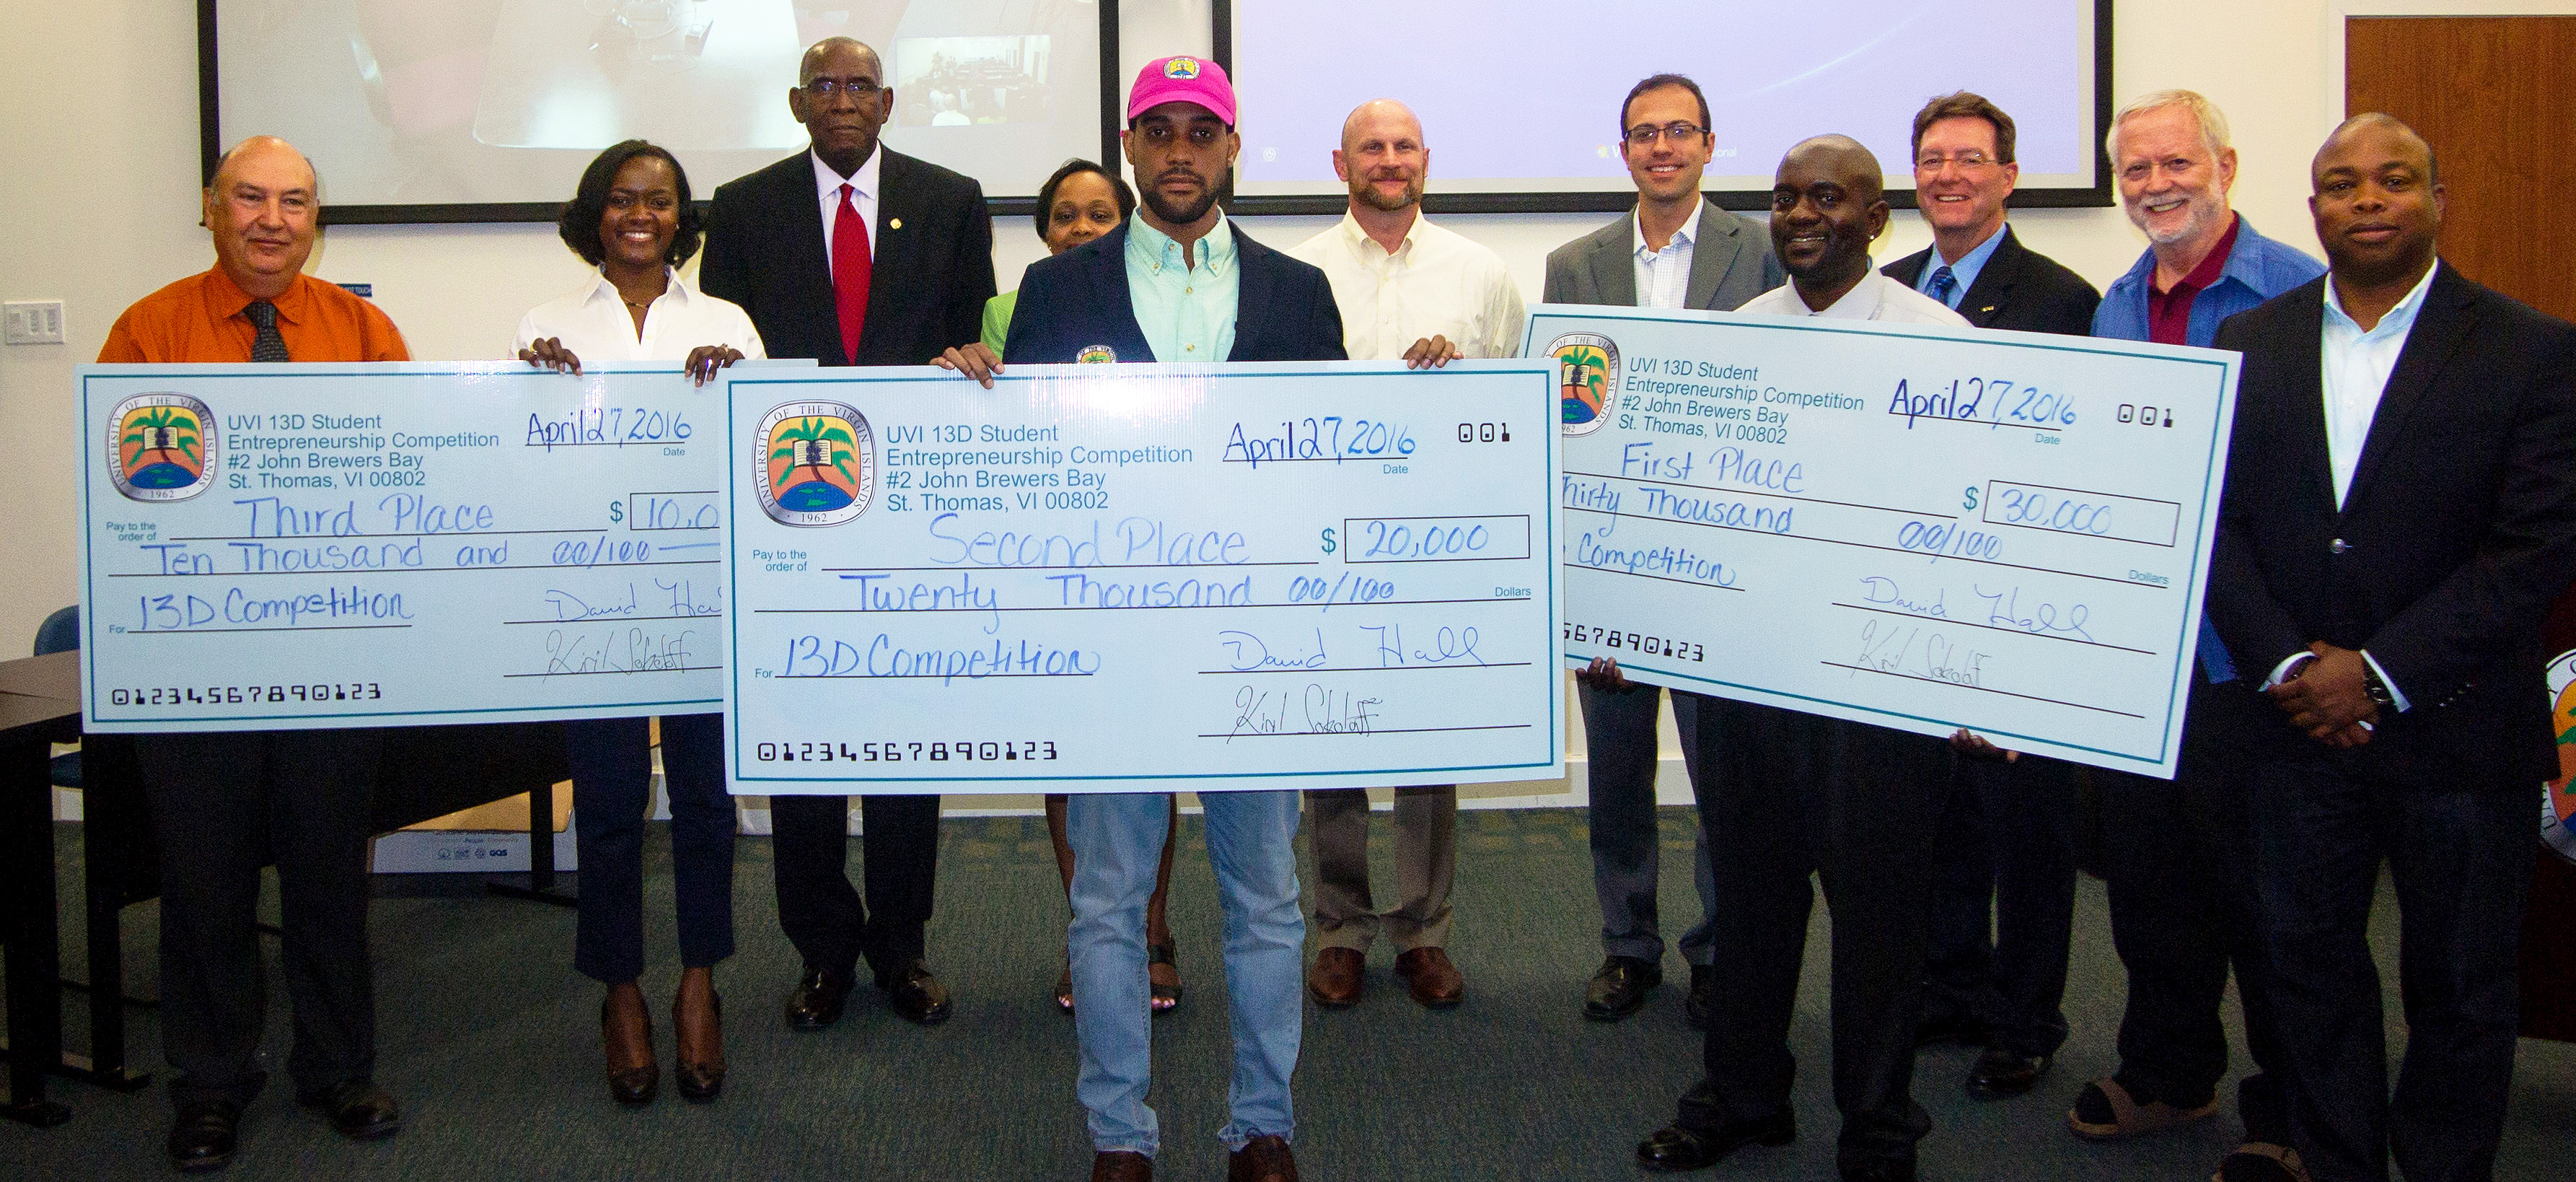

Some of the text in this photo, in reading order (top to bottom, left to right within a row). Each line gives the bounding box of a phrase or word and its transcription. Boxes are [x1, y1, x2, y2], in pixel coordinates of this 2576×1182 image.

[1556, 338, 1568, 347] OF
[1597, 338, 1618, 370] VIRGIN
[1629, 357, 1759, 382] UVI 13D Student
[1595, 377, 1616, 425] ISLANDS
[1625, 376, 1865, 412] Entrepreneurship Competition
[228, 413, 382, 431] UVI 13D Student
[1622, 397, 1790, 426] #2 John Brewers Bay
[2117, 403, 2173, 428] 001
[887, 424, 1059, 442] UVI 13D Student
[1459, 422, 1511, 443] 001
[1619, 414, 1788, 445] St. Thomas, VI 00802
[2035, 434, 2062, 446] Date
[110, 416, 127, 486] UNIVERSITY
[126, 399, 139, 411] OF
[180, 398, 212, 429] VIRGIN
[198, 437, 214, 487] ISLANDS
[228, 432, 500, 451] Entrepreneurship Competition
[663, 447, 685, 456] Date
[228, 452, 424, 471] #2 John Brewers Bay
[757, 406, 871, 509] UNIVERSITY OF THE VIRGIN ISLANDS
[887, 445, 1192, 468] Entrepreneurship Competition
[1621, 442, 1805, 494] First Place
[228, 471, 426, 489] St. Thomas, VI 00802
[887, 469, 1106, 491] #2 John Brewers Bay
[1383, 465, 1408, 474] Date
[151, 490, 175, 499] 1962
[887, 491, 1109, 514] St. Thomas, VI 00802
[234, 492, 494, 538] Third Place
[610, 497, 718, 532] $ 10,0
[801, 513, 827, 522] 1962
[1563, 476, 2003, 564] hirty Thousand 00/100
[1963, 486, 2113, 535] $ 30,000
[106, 521, 157, 533] Pay to the
[118, 532, 157, 541] order of
[930, 513, 1251, 569] Second Place
[1321, 520, 1490, 559] $ 20,000
[140, 535, 650, 576] Ten Thousand and 00/100
[752, 549, 807, 561] Pay to the
[765, 561, 807, 572] order of
[1578, 533, 1736, 587] Competition
[2129, 569, 2171, 585] Dollars
[655, 577, 722, 616] Ha
[839, 571, 1396, 634] Twenty Thousand 00/100
[1495, 585, 1531, 597] Dollars
[141, 585, 415, 631] 13D Competition
[109, 624, 127, 634] For
[1360, 623, 1488, 669] Hall
[1564, 622, 1705, 662] 567890123
[786, 633, 1101, 688] 13D Competition
[755, 668, 773, 678] For
[112, 683, 382, 706] 01234567890123
[757, 740, 1058, 761] 01234567890123
